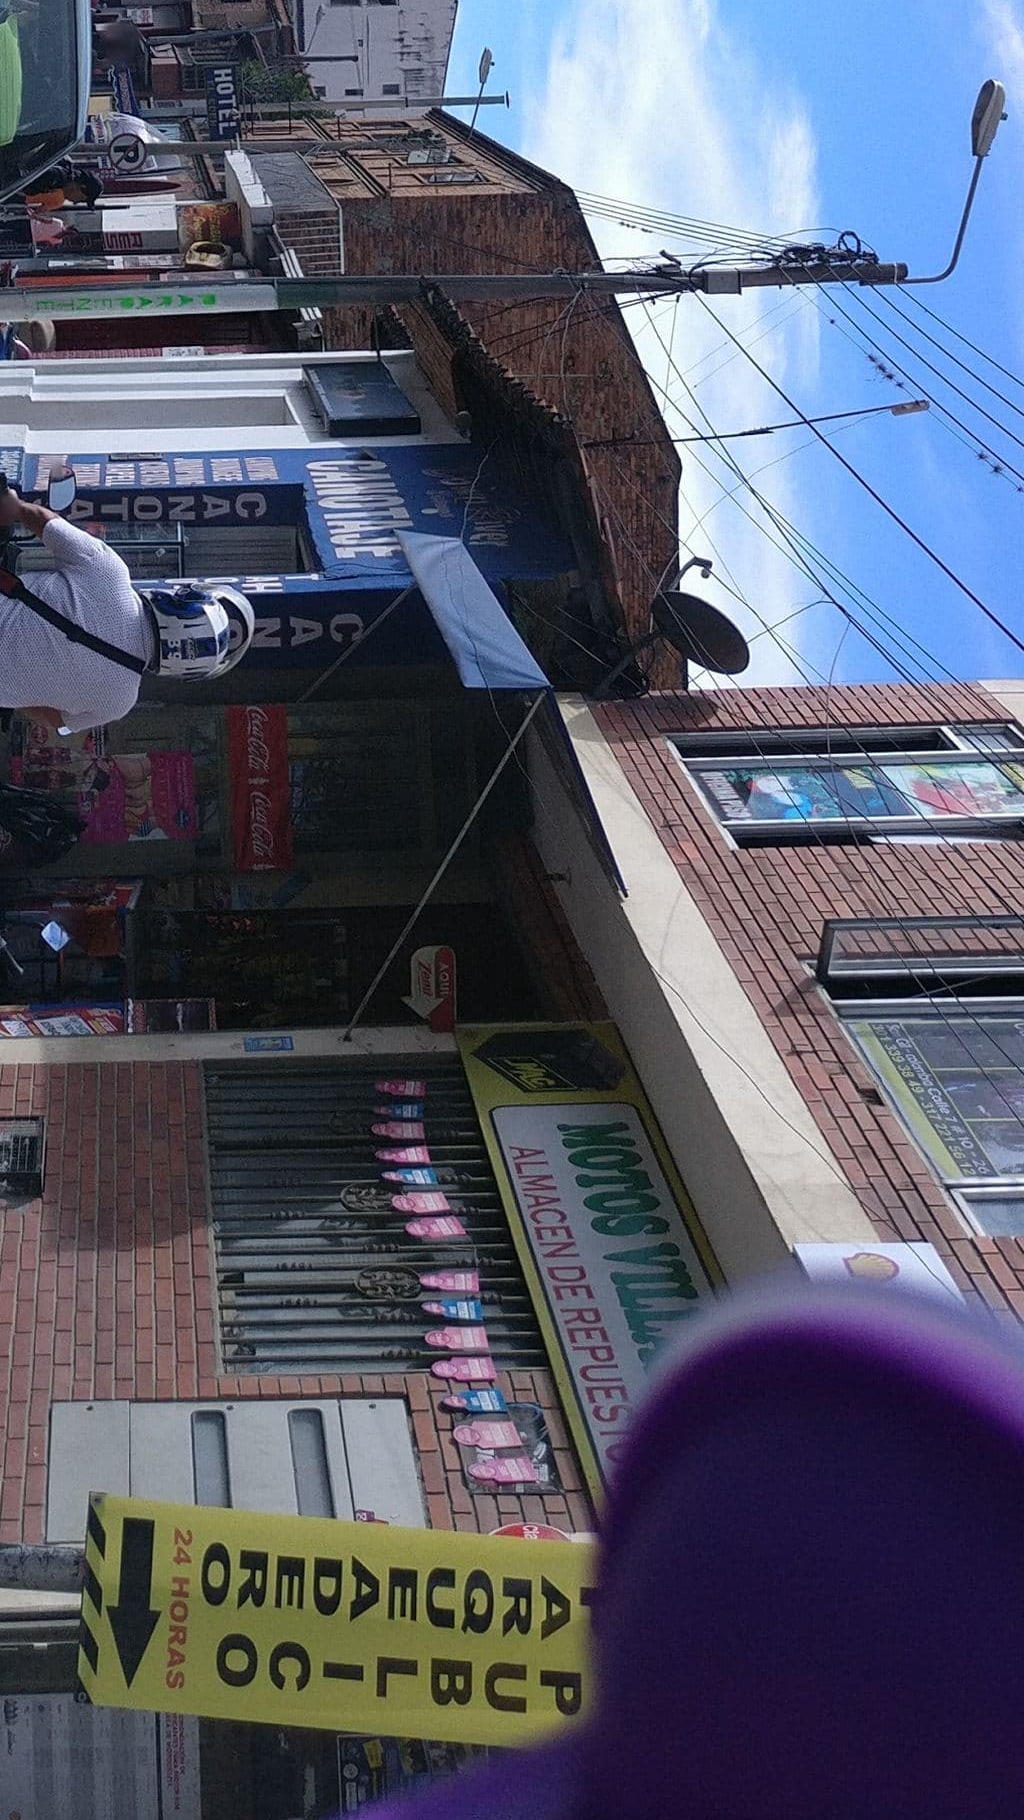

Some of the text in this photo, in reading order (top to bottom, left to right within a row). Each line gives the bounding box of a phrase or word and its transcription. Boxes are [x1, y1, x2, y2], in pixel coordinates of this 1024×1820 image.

[213, 68, 238, 135] HOTEL
[36, 293, 216, 312] PARAPENTE
[306, 460, 414, 559] CANOTAJE
[881, 1044, 904, 1063] 339
[897, 1065, 914, 1078] 38
[907, 1080, 924, 1093] 49
[920, 1102, 942, 1121] 317
[933, 1123, 953, 1142] 221
[948, 1145, 965, 1159] 56
[960, 1162, 977, 1176] 12
[927, 1087, 949, 1115] Calle
[950, 1125, 962, 1134] #
[957, 1136, 974, 1149] 10
[972, 1159, 990, 1174] 26
[509, 1146, 581, 1260] ALMACEN
[546, 1266, 593, 1301] DE
[557, 1122, 670, 1236] MOTOS
[165, 1529, 193, 1690] 24 HORAS
[216, 1633, 582, 1716] PUBLICO
